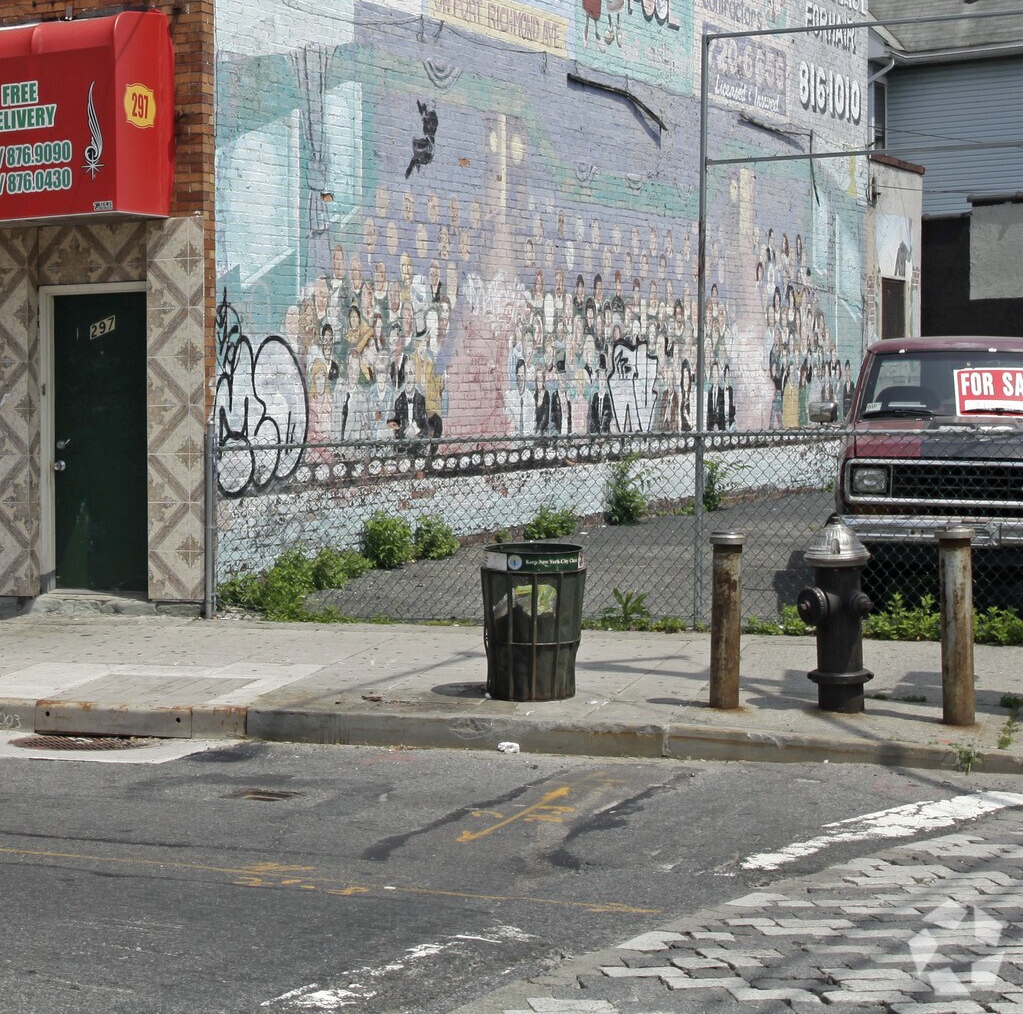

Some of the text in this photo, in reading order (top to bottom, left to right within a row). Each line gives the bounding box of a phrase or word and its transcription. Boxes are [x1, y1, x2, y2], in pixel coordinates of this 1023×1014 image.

[2, 82, 37, 106] FREE
[132, 93, 148, 118] 297
[91, 317, 115, 339] 297
[960, 372, 994, 396] FOR
